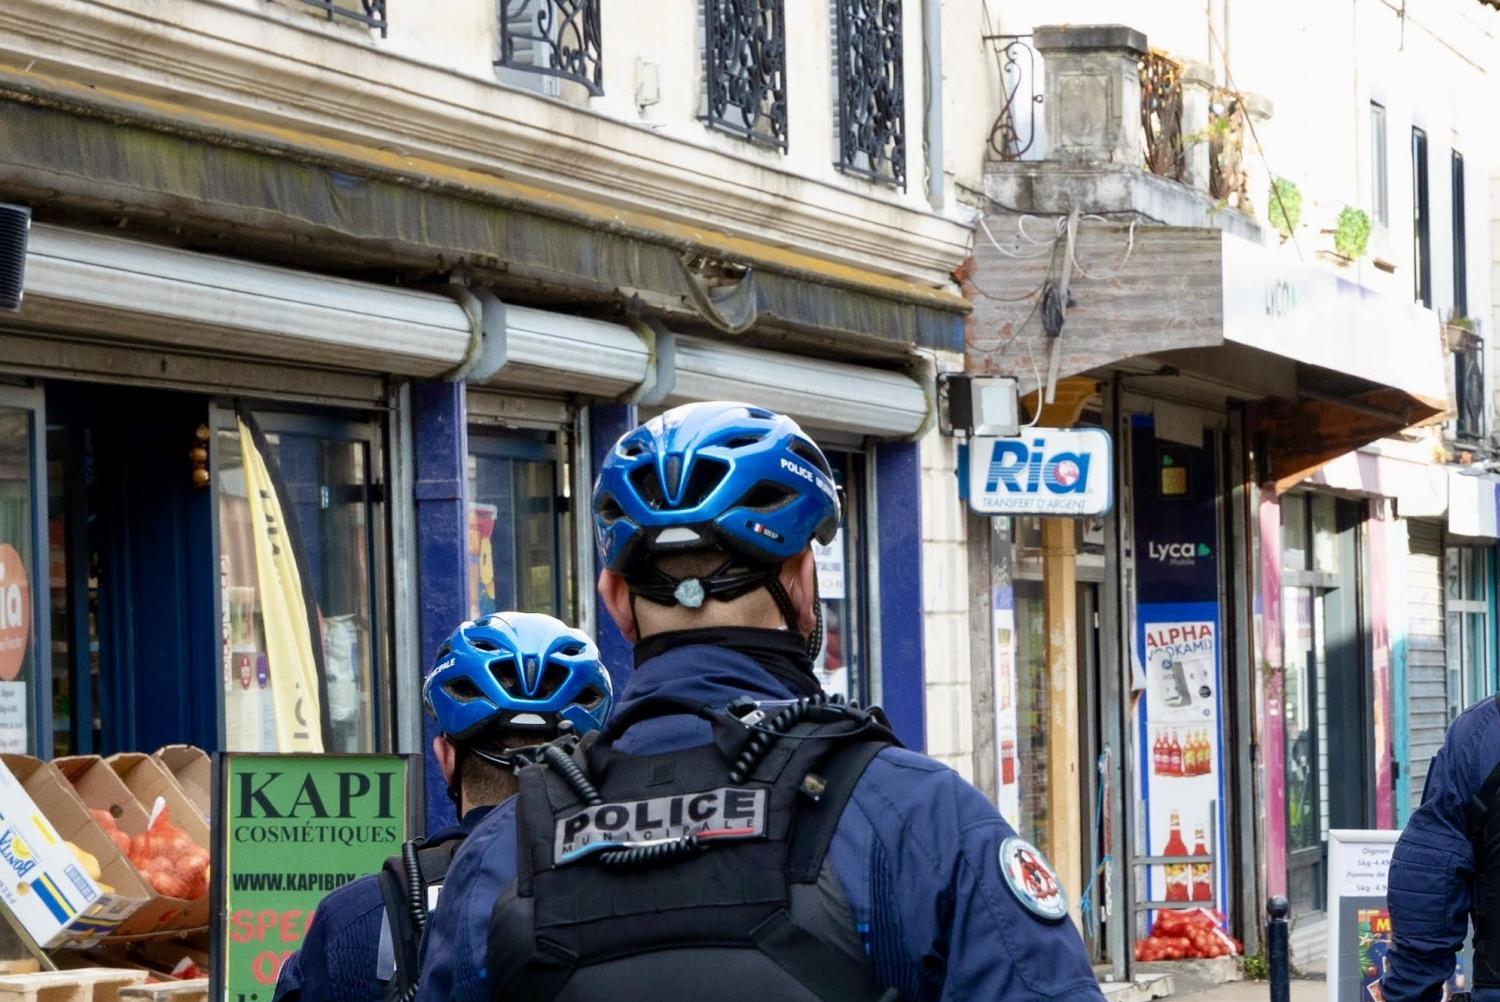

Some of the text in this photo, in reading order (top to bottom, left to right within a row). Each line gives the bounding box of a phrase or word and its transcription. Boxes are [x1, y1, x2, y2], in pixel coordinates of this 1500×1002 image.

[781, 458, 813, 482] POLICE
[985, 438, 1091, 494] Ria
[983, 498, 1034, 508] TRANSFERT
[1149, 541, 1196, 561] Lyca
[1147, 625, 1212, 648] ALPHA
[234, 771, 397, 819] KAPI
[563, 789, 757, 845] POLICE
[234, 821, 397, 846] COSMÉTIQUES
[562, 818, 756, 854] MUNICIPALE
